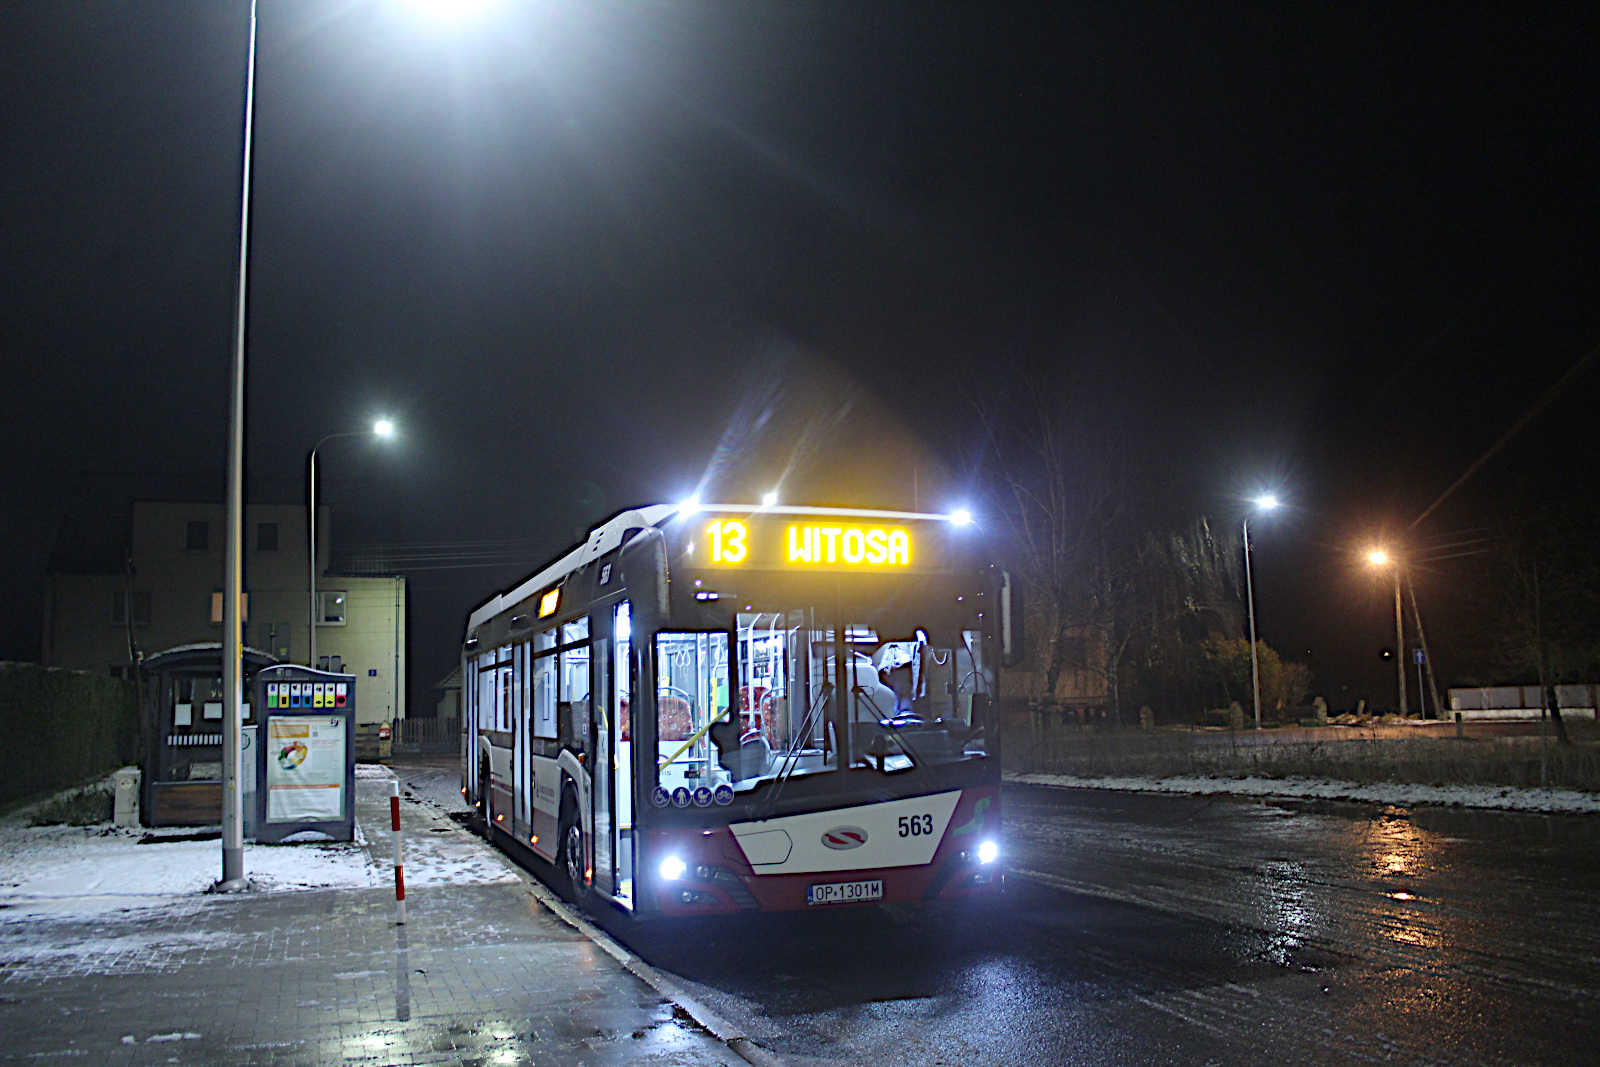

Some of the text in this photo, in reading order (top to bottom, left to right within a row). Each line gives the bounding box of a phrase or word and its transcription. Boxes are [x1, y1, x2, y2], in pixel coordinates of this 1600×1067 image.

[705, 519, 910, 565] 13 WITOSA
[898, 814, 933, 837] 563
[815, 882, 879, 900] OP 1301M
